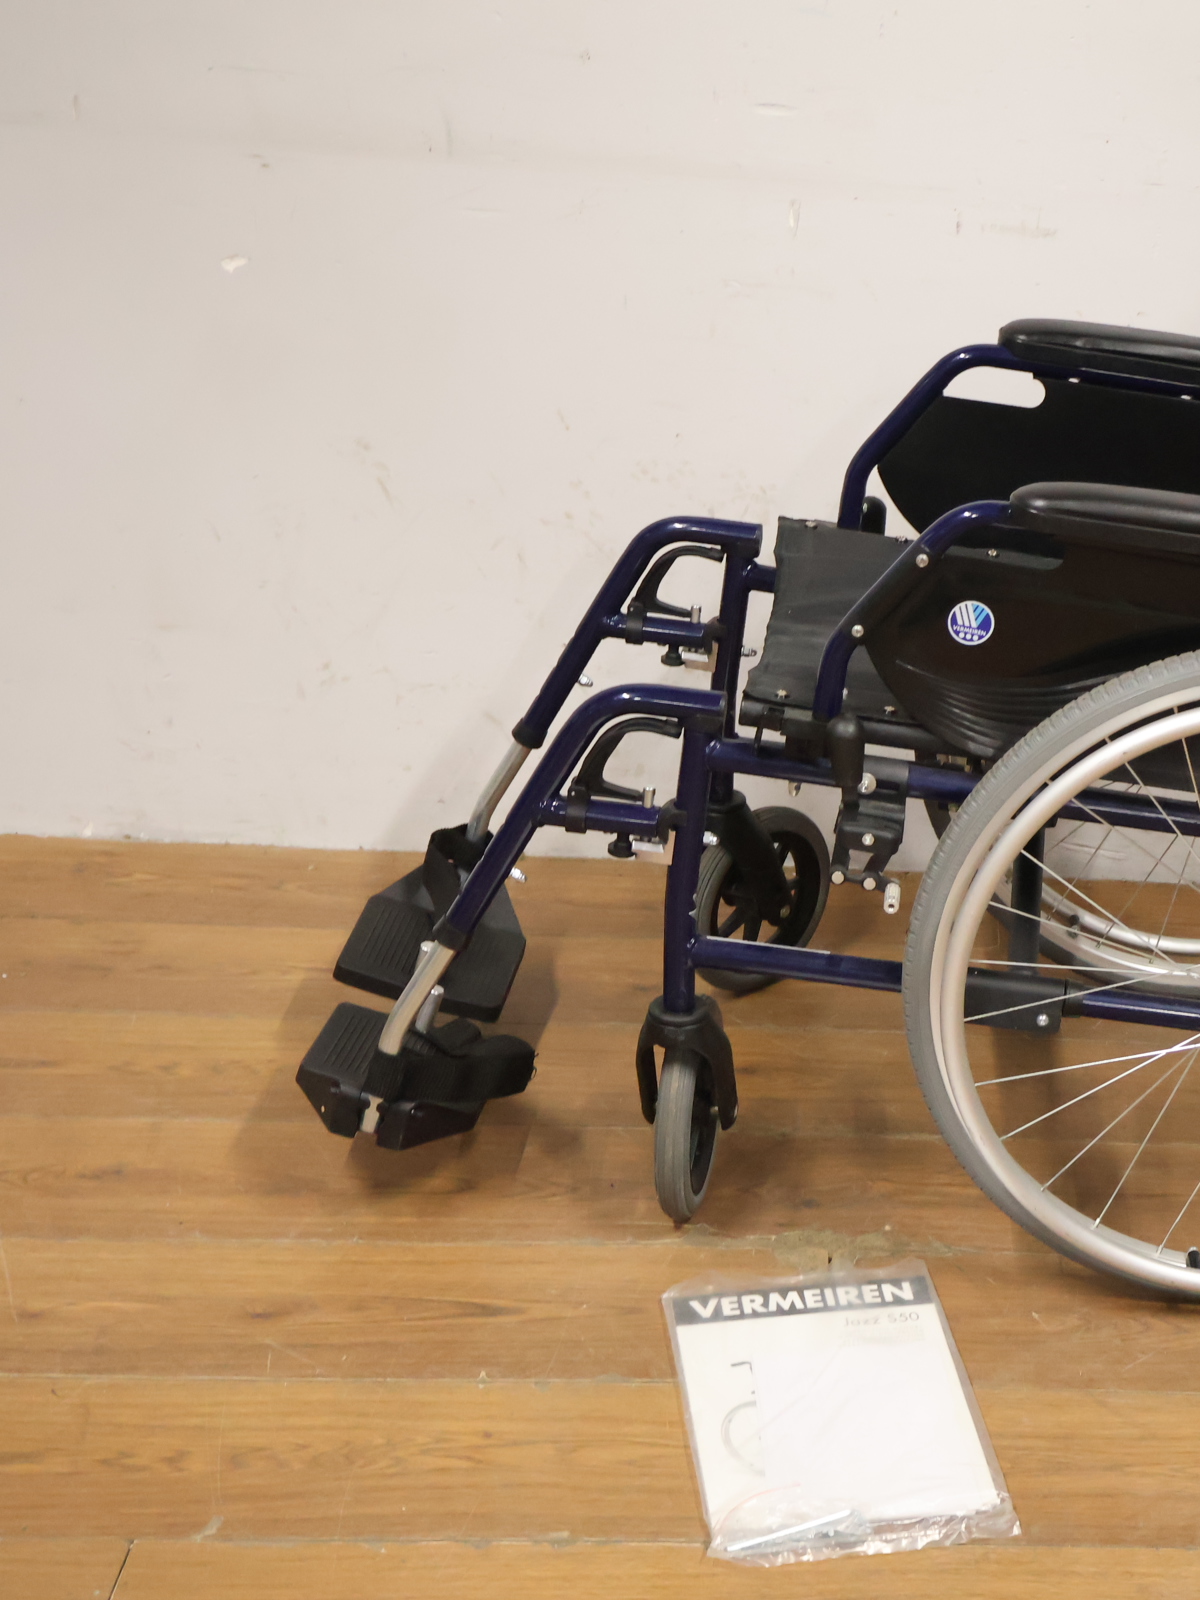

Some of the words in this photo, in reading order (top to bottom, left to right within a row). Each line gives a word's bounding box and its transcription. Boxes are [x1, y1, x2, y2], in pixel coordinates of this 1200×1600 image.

[953, 624, 987, 636] VERMEIREN
[689, 1281, 915, 1319] VERMEIREN
[843, 1314, 881, 1327] Jazz
[887, 1311, 920, 1324] S50
